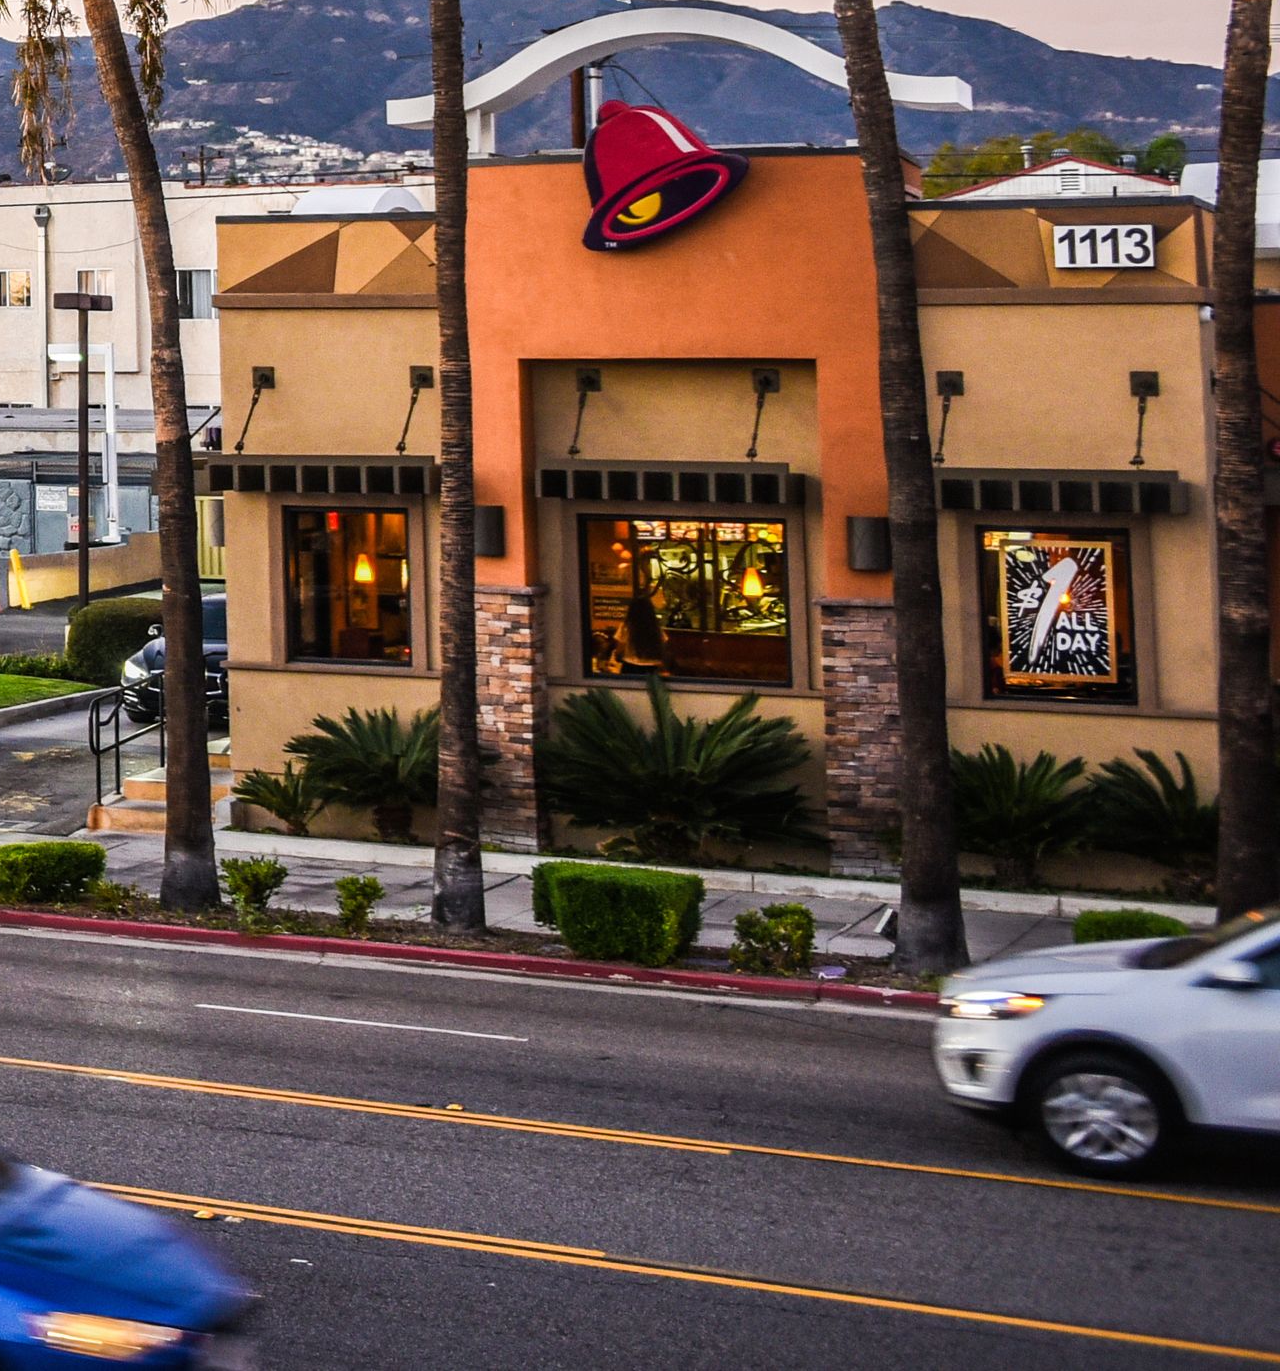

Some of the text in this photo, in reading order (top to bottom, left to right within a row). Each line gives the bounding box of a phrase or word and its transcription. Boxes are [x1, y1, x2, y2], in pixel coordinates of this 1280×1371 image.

[1057, 227, 1152, 265] 1113
[1056, 611, 1100, 631] ALL
[1056, 633, 1100, 651] DAY
